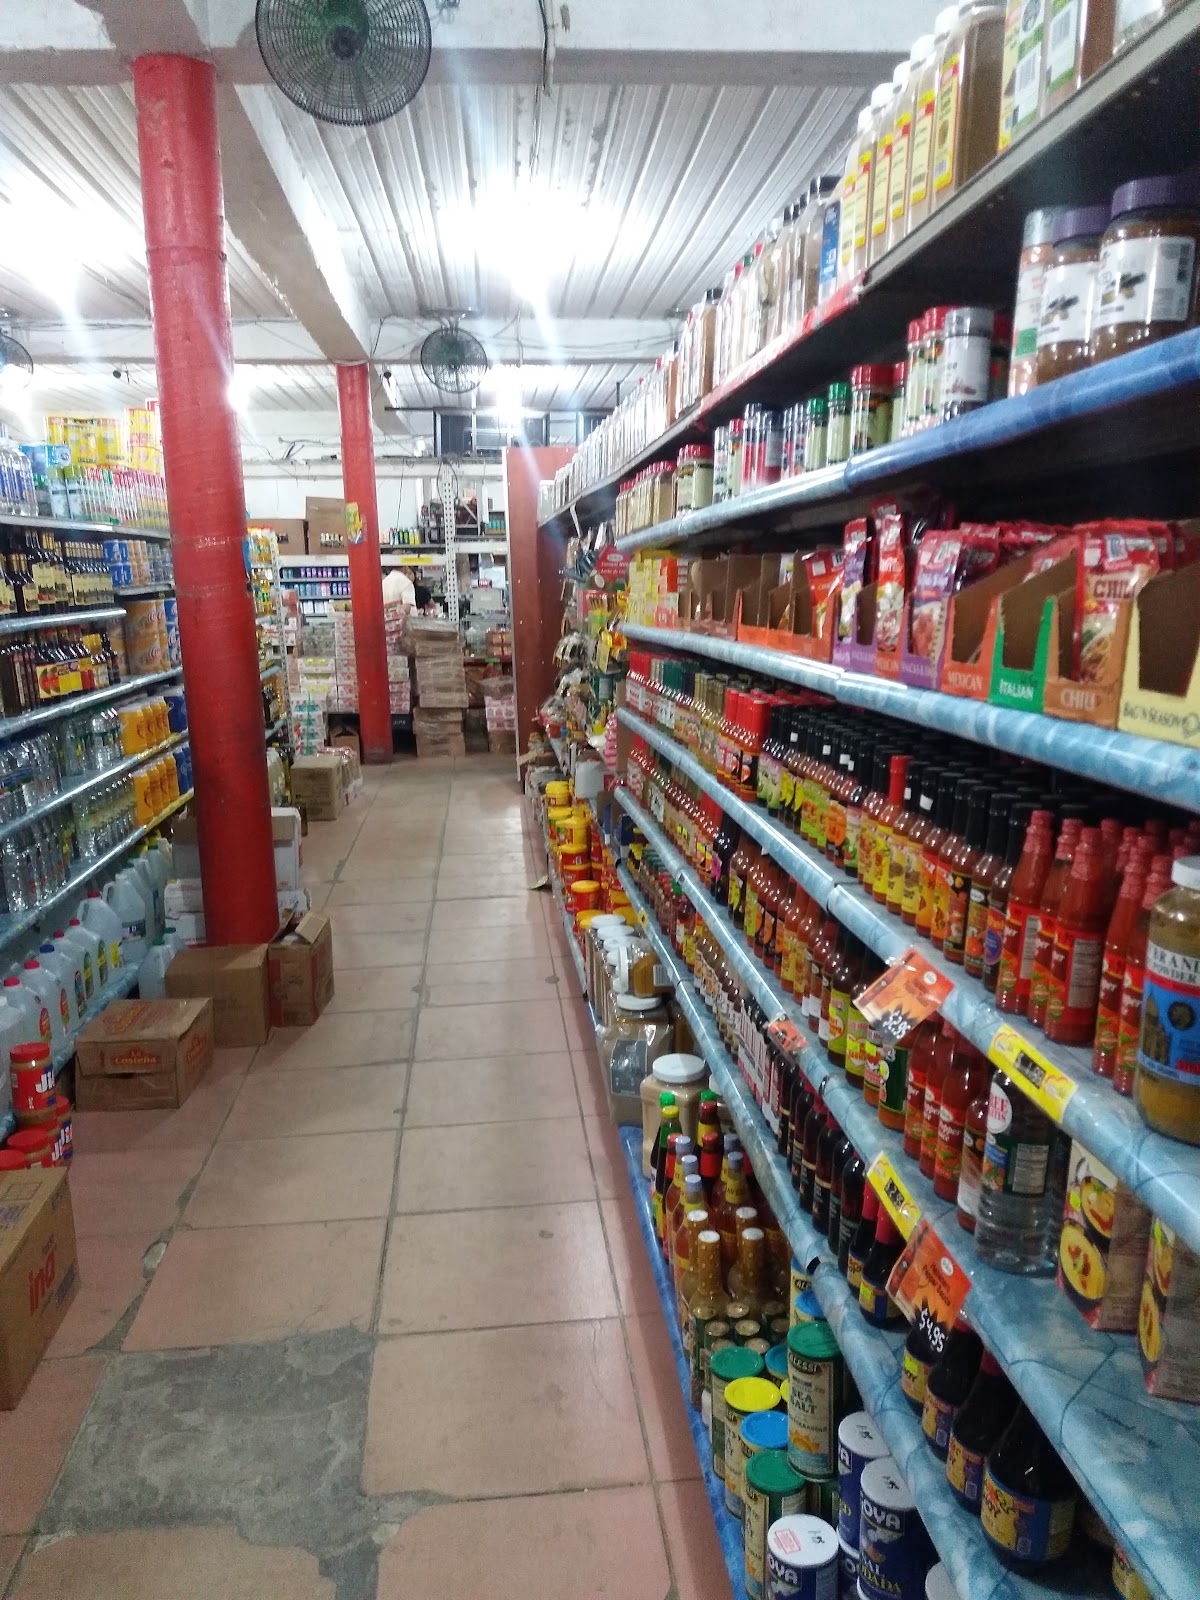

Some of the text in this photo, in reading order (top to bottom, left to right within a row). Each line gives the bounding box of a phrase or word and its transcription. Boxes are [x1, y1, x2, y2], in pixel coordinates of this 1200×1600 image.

[948, 671, 983, 692] MEXICAN
[999, 678, 1035, 701] ITALIAN
[1060, 688, 1097, 712] CHILI
[919, 1309, 946, 1353] $4.95
